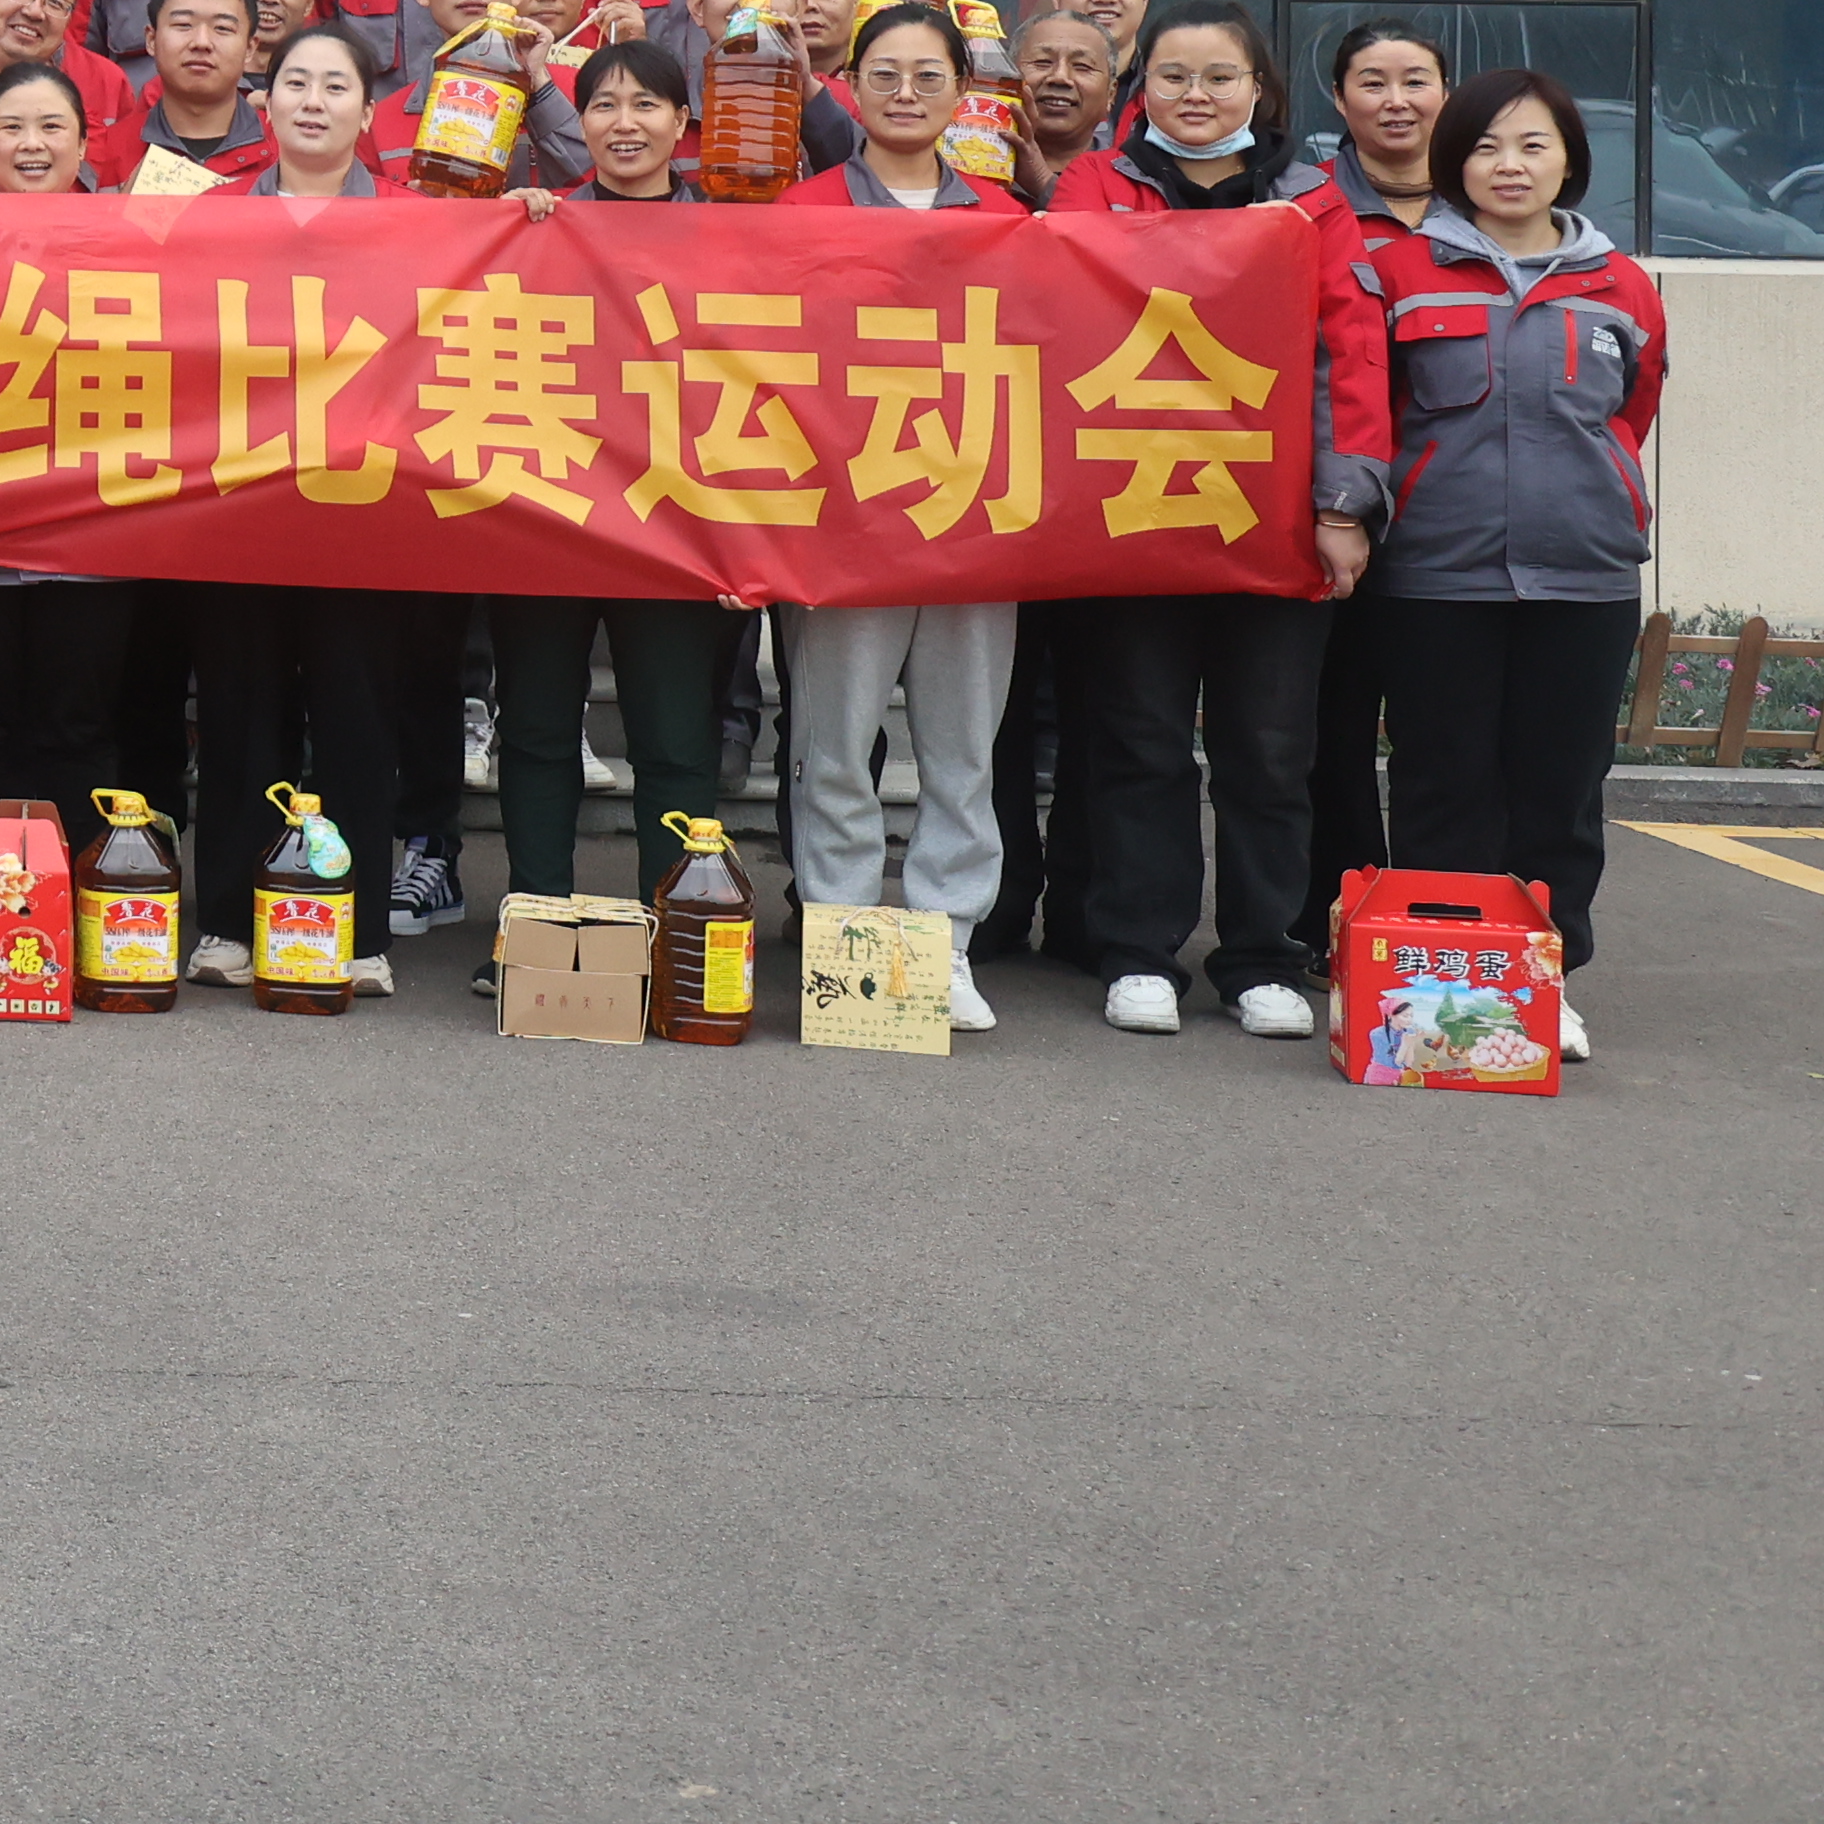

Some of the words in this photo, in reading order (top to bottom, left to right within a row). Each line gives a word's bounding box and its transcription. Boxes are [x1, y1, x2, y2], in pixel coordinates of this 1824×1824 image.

[453, 79, 488, 102] 鲁花
[964, 96, 999, 117] 鲁花
[119, 900, 154, 918] 鲁花
[284, 899, 320, 919] 鲁花
[8, 936, 44, 975] 福
[1392, 945, 1512, 981] 鲜鸡蛋
[267, 965, 295, 976] 中国味
